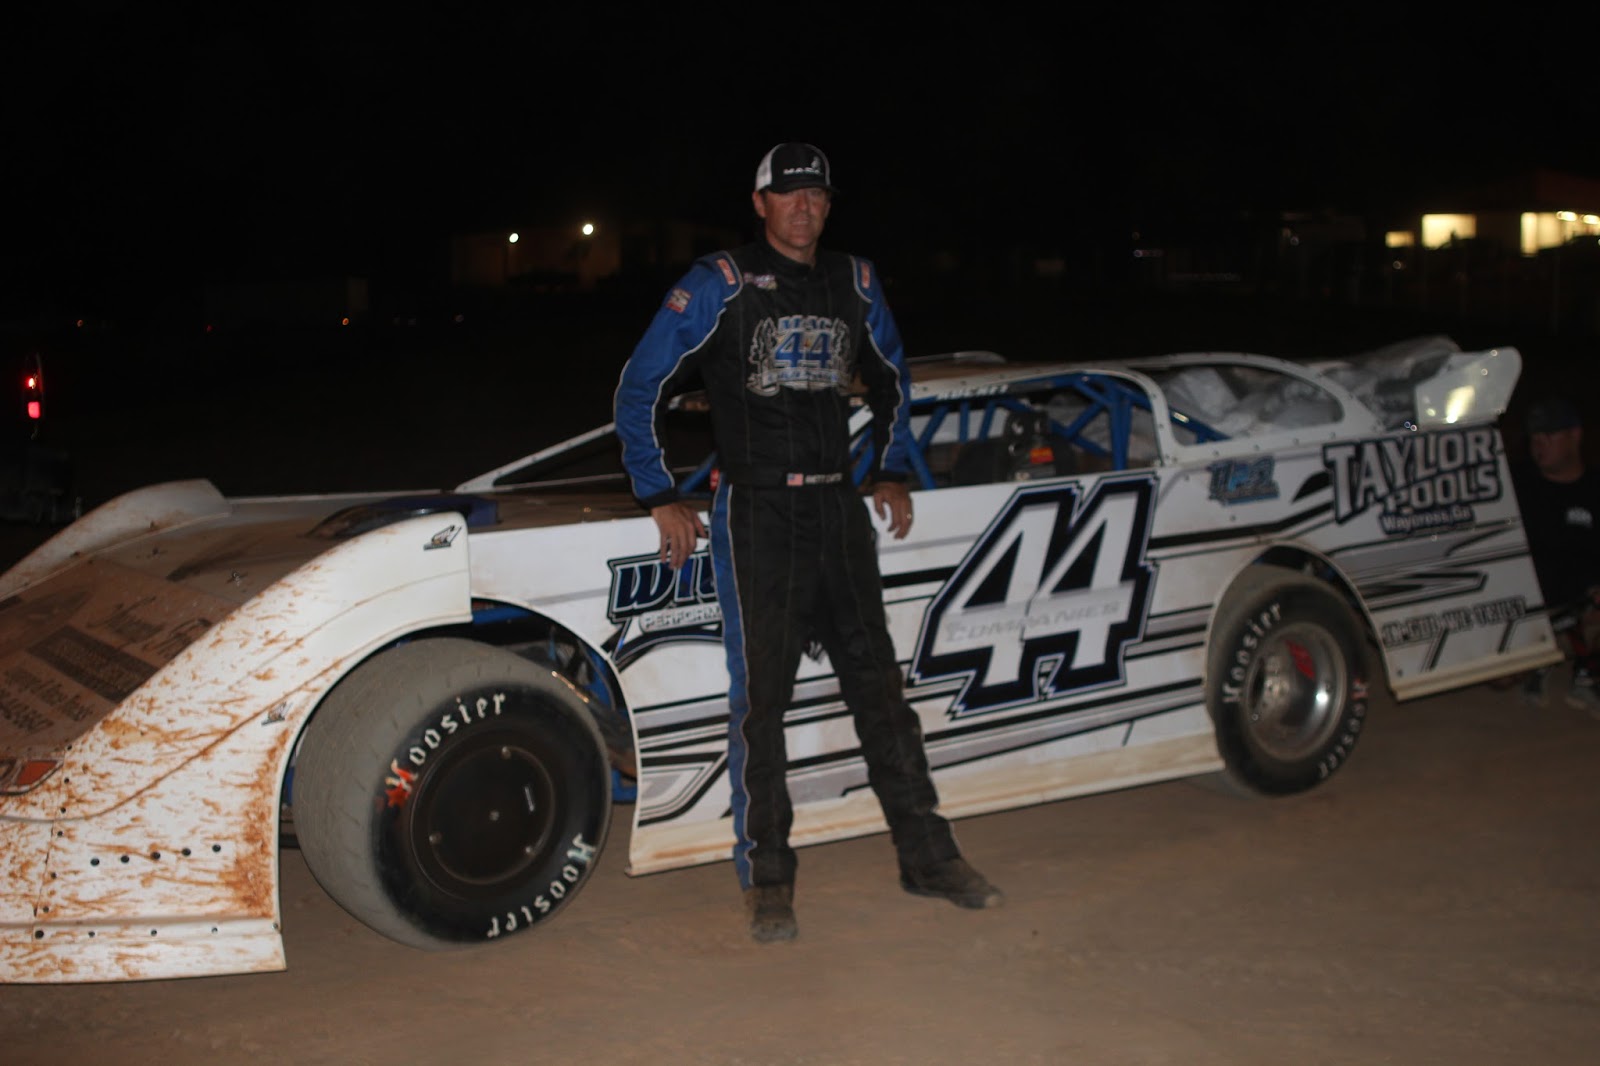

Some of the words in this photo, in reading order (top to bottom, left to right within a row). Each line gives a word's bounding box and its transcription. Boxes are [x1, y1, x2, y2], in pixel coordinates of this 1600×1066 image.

[774, 331, 832, 369] 44
[1324, 430, 1495, 522] TAYLOR
[1384, 463, 1500, 515] POOLS
[919, 477, 1156, 714] 44
[1222, 603, 1281, 704] Hoosier
[384, 693, 506, 793] Hoosier
[1317, 678, 1369, 780] Hoosier
[487, 833, 597, 939] Hoosier
